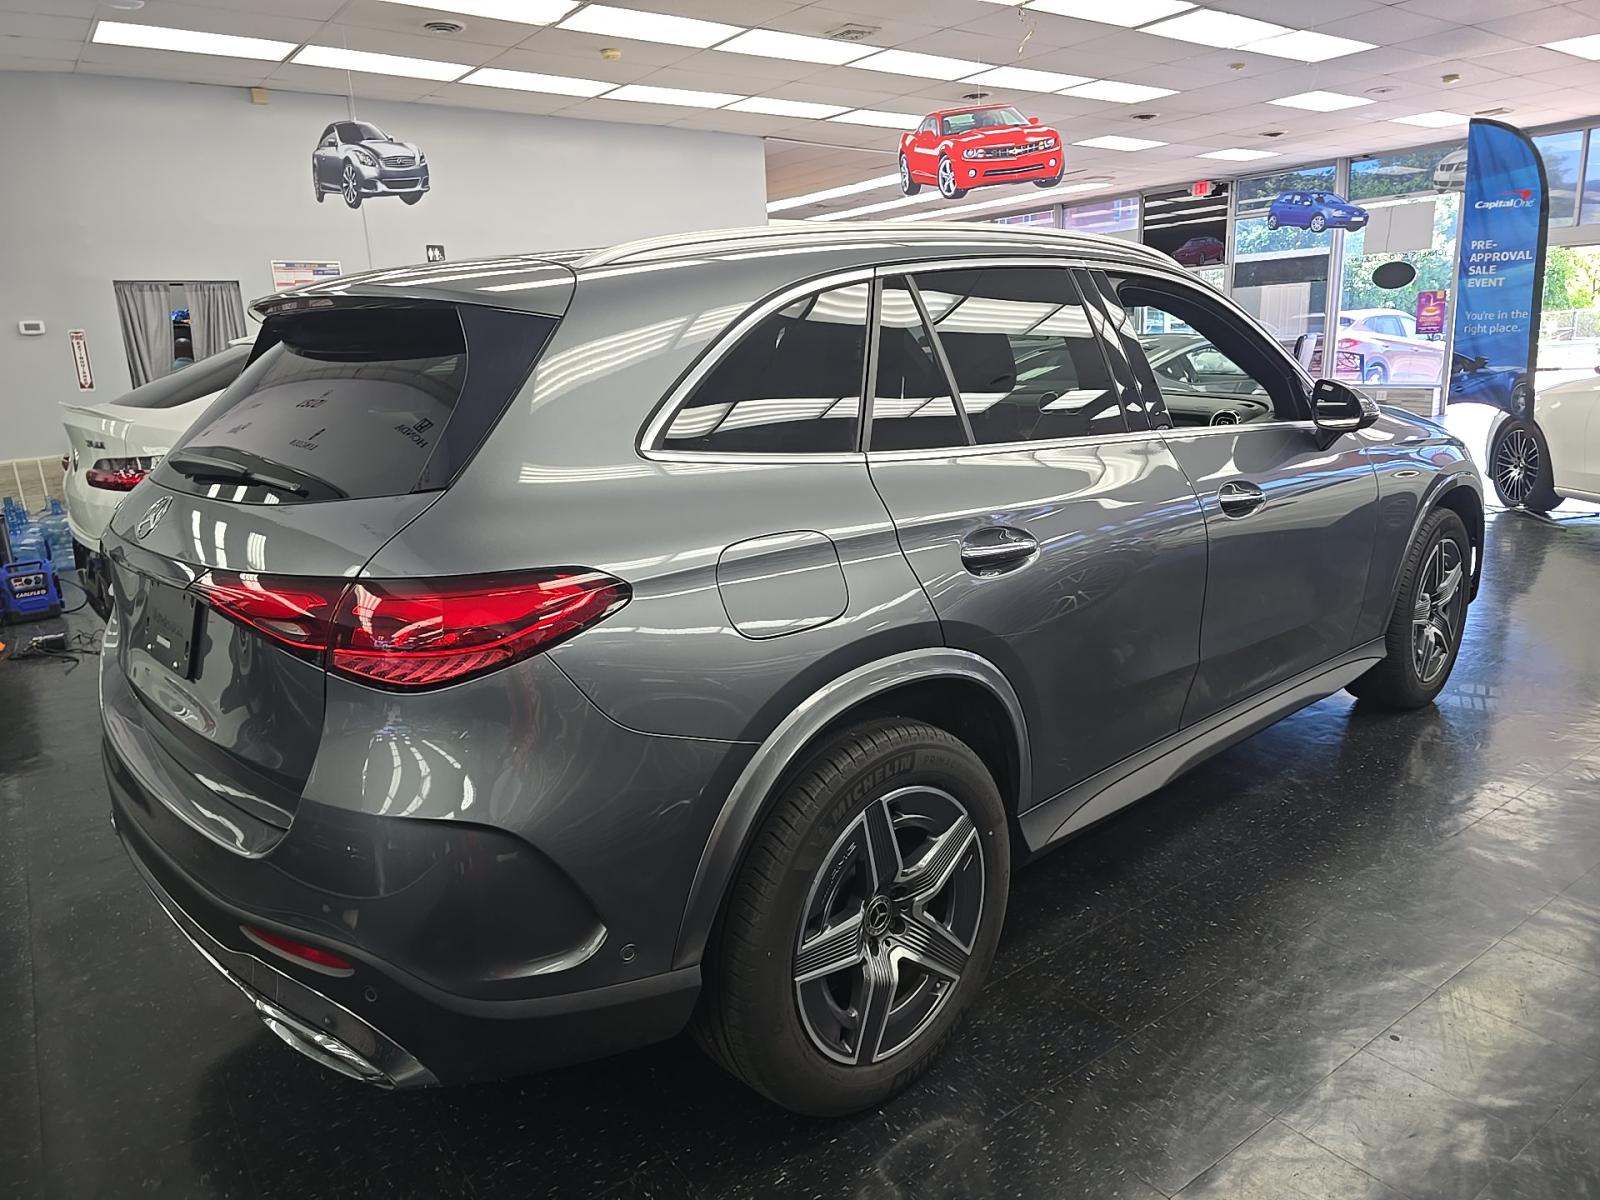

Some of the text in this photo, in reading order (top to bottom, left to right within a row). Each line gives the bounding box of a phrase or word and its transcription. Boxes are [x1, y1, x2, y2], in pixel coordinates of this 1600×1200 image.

[1471, 240, 1498, 250] PRE-
[1469, 250, 1533, 263] APPROVAL
[1468, 264, 1497, 276] SALE
[1467, 277, 1505, 288] EVENT
[1465, 309, 1529, 321] You're in the
[1464, 323, 1521, 336] right place.
[833, 754, 914, 823] MICHELIN
